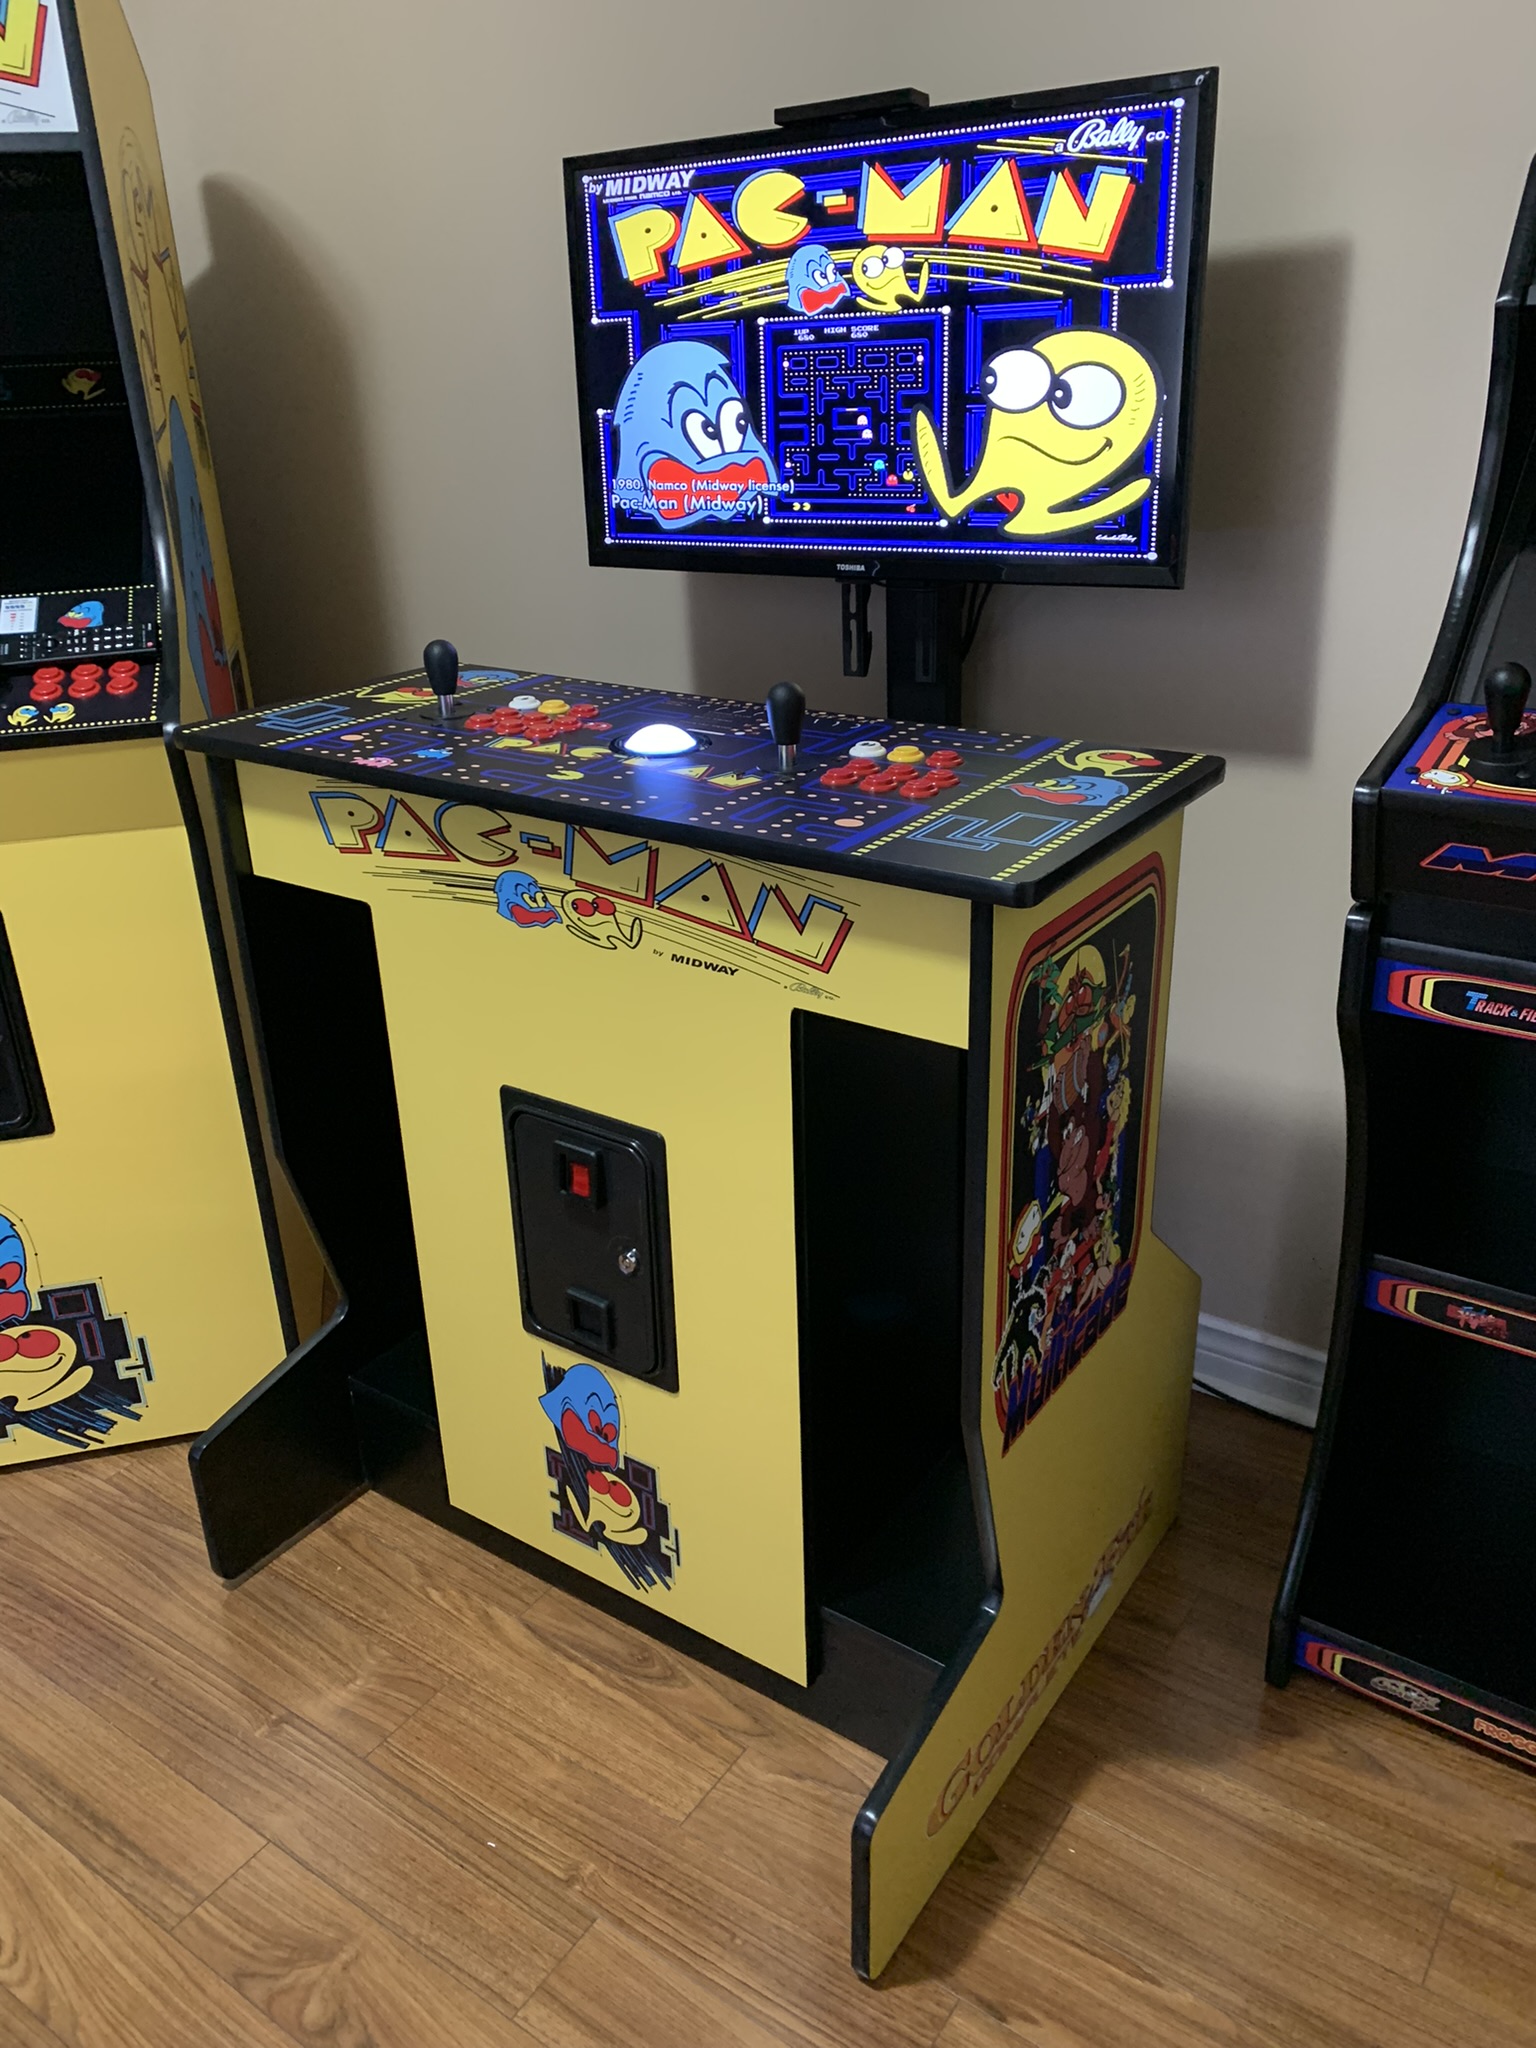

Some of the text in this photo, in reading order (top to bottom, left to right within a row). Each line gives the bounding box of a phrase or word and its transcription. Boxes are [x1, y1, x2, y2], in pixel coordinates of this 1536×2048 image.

[1054, 116, 1170, 153] a Bally co.
[589, 169, 696, 197] by MIDWAY
[608, 157, 1135, 285] PAC-MAN
[793, 324, 880, 336] 1UP HIGH SCORE
[850, 331, 869, 339] 650
[612, 479, 795, 494] 1980, Namco (Midway license)
[612, 495, 763, 516] Pac-Man (Midway)
[836, 563, 866, 571] TOSHIBA
[309, 791, 854, 974] PAC-MAN
[653, 949, 740, 976] by MIDWAY
